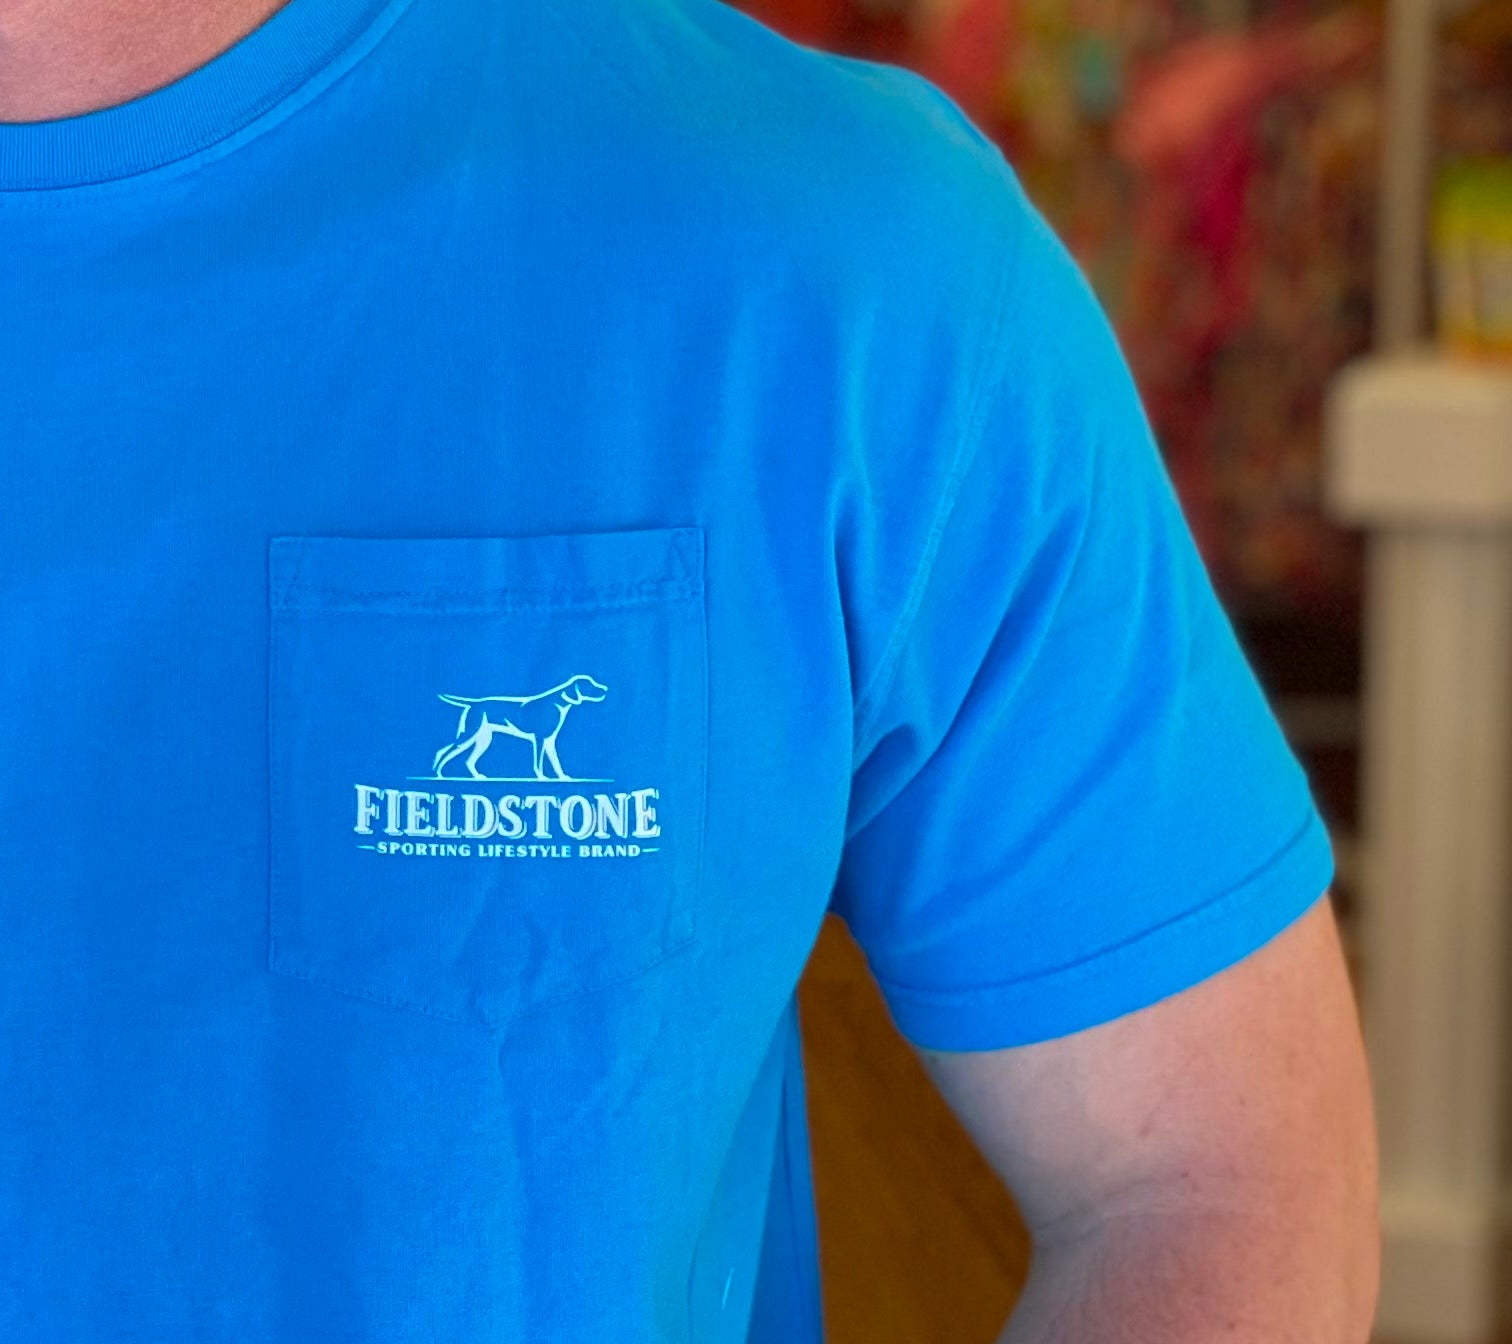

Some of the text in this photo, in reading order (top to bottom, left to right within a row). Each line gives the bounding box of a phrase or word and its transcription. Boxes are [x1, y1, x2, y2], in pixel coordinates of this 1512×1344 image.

[354, 783, 661, 839] FIELDSTONE
[376, 841, 640, 859] SPORTING LIFESTYLE BRAND
